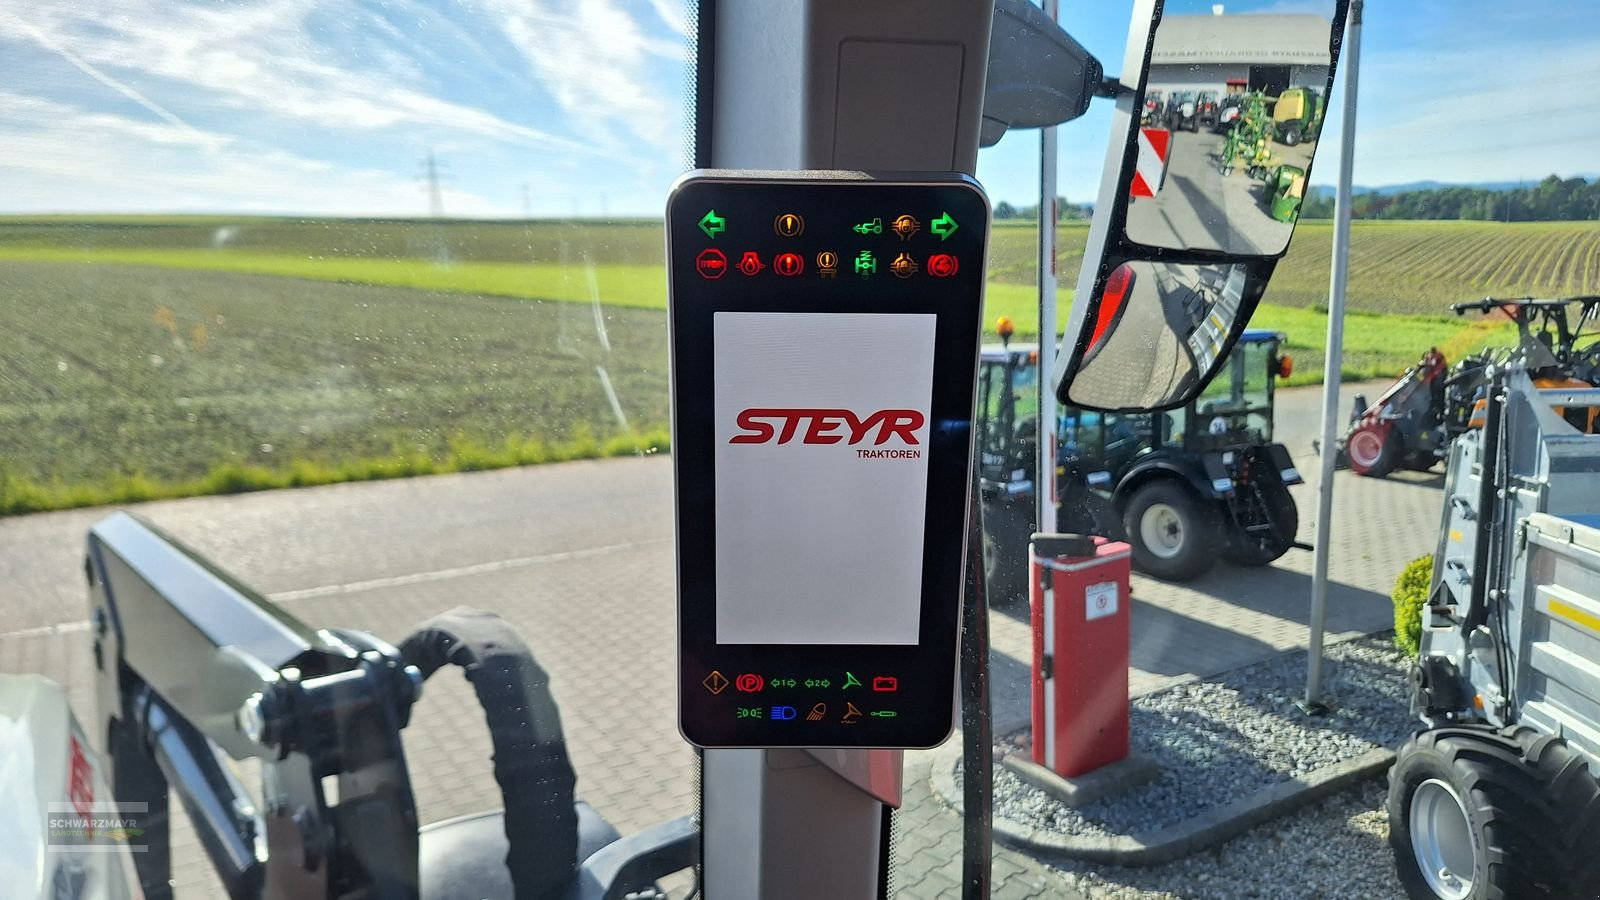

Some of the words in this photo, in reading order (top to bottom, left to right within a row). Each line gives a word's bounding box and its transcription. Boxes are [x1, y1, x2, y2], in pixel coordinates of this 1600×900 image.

[728, 408, 925, 446] STEYR
[856, 449, 921, 459] TRAKTOREN
[747, 678, 755, 687] P
[814, 679, 820, 687] 2
